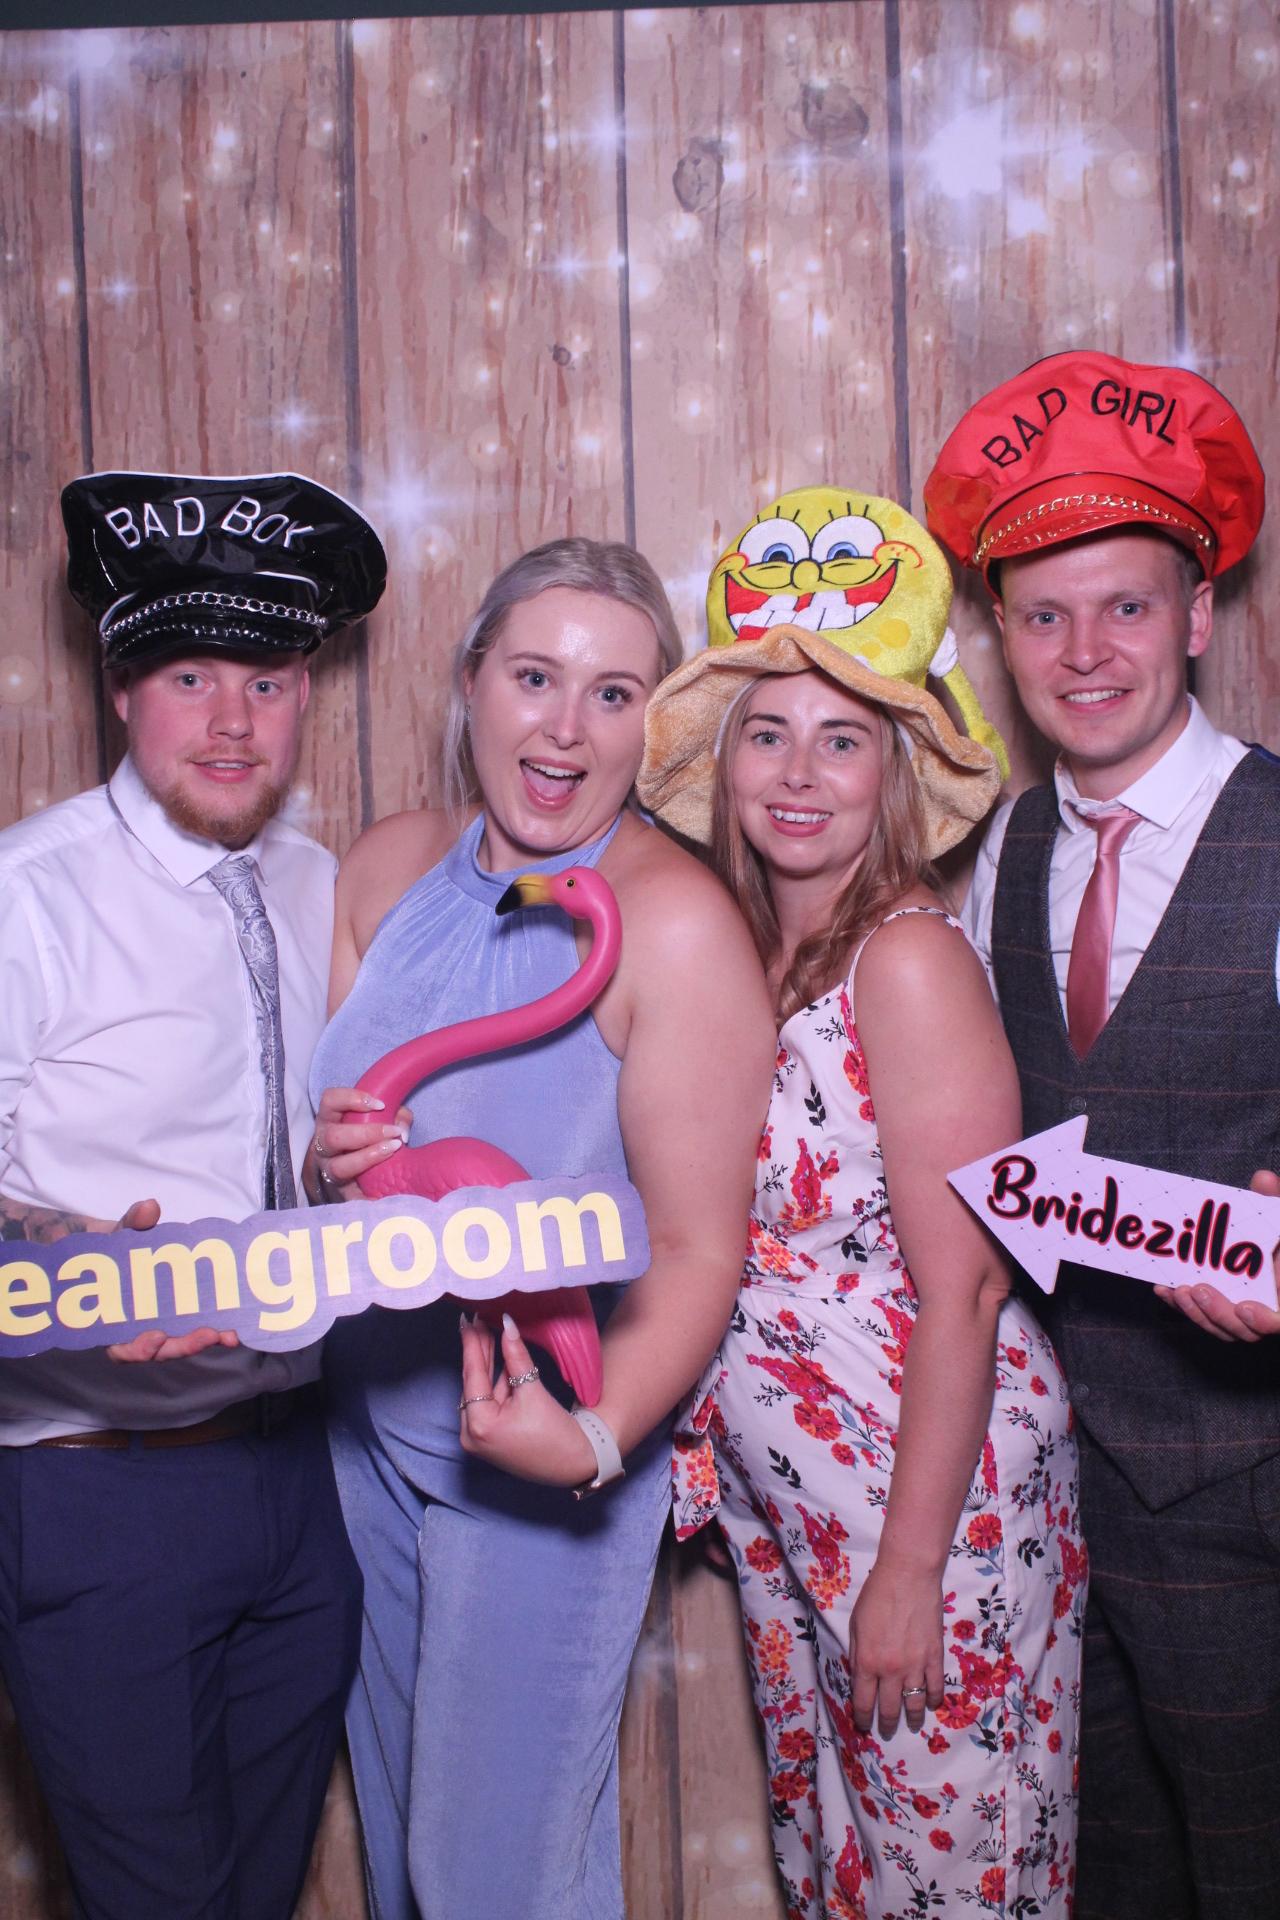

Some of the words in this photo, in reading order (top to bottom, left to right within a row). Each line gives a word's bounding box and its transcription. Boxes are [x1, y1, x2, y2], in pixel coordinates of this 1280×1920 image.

[981, 387, 1068, 469] BAD
[1090, 379, 1177, 446] GIRL
[104, 496, 206, 550] BAD
[220, 495, 314, 549] BOY
[986, 1154, 1264, 1280] Bridezilla
